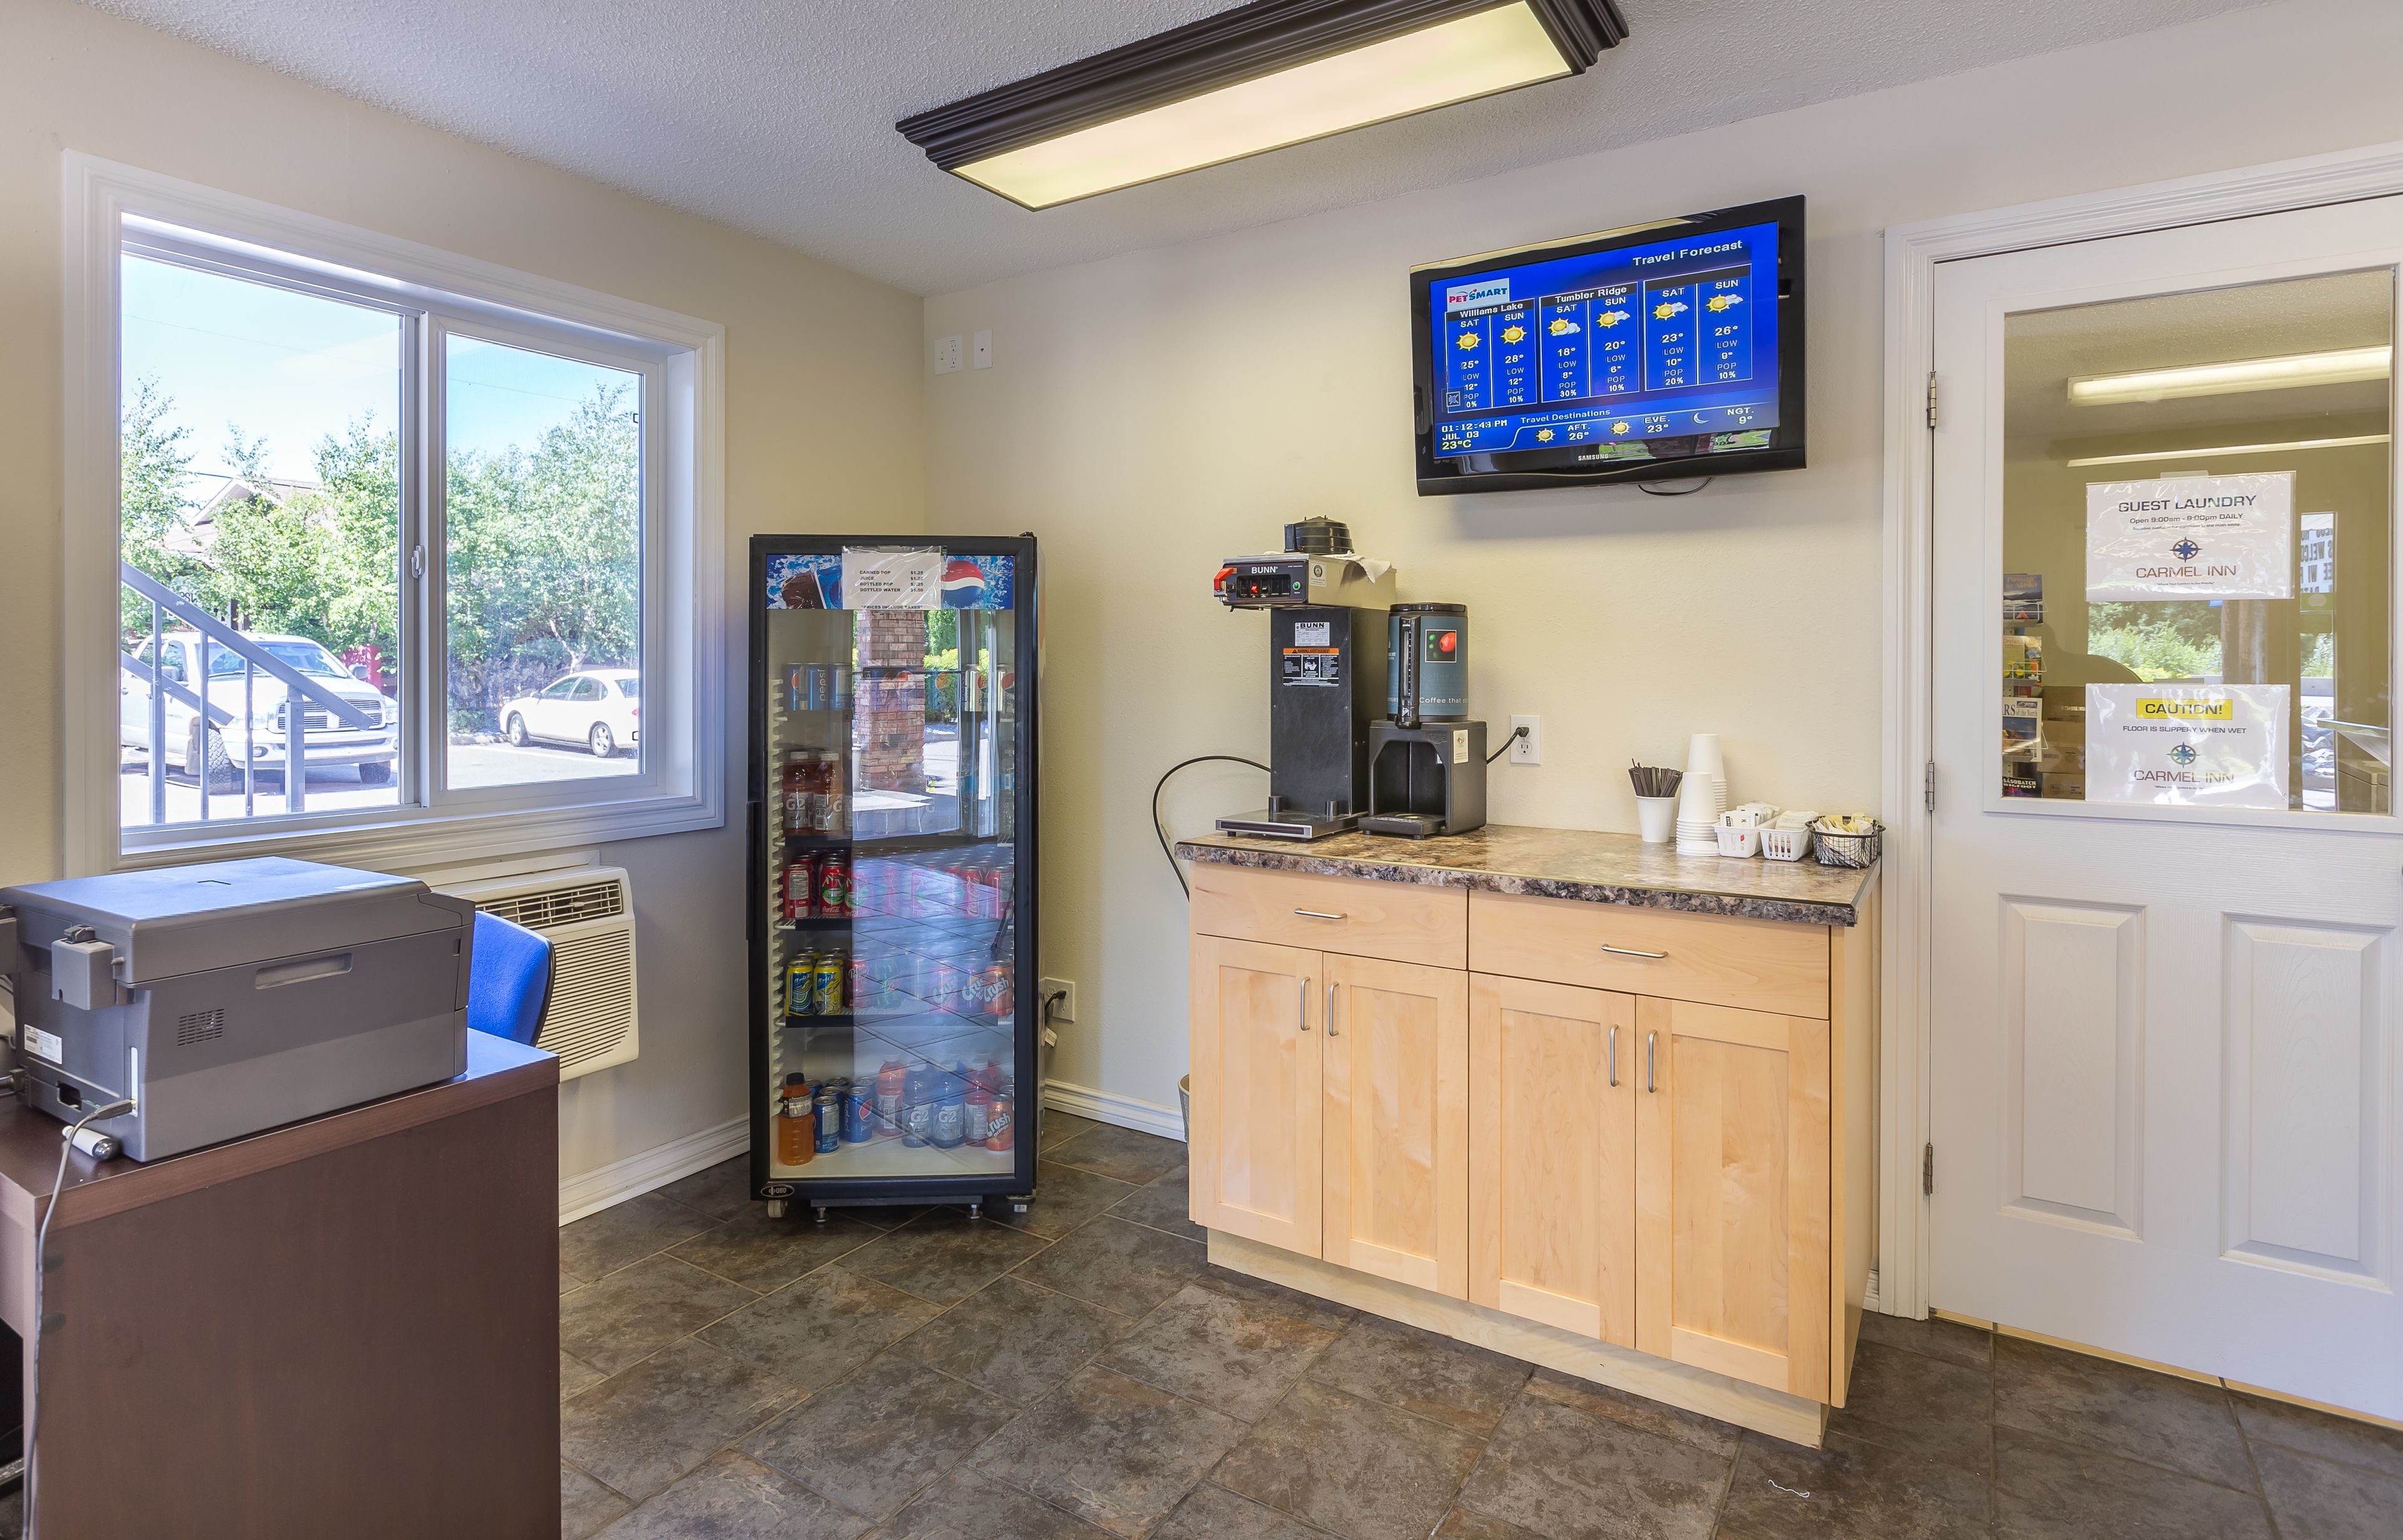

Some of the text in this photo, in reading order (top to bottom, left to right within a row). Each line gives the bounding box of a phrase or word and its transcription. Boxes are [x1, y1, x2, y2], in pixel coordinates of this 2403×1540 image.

[1633, 240, 1742, 265] Travel Forecast
[1715, 280, 1738, 289] SUN
[1554, 287, 1627, 303] Tumbler Ridge
[1662, 287, 1685, 297] SAT
[1605, 297, 1626, 306] SUN
[1460, 303, 1524, 318] Williams Lake
[1556, 304, 1578, 313] SAT
[1504, 312, 1524, 321] SUN
[1460, 319, 1479, 328] SAT
[1662, 333, 1684, 344] 23°
[1605, 340, 1625, 351] 20°
[1717, 340, 1738, 349] LOW
[1558, 347, 1576, 357] 18°
[1664, 347, 1684, 355] LOW
[1606, 354, 1626, 362] LOW
[1666, 358, 1682, 366] 10°
[1558, 360, 1576, 369] LOW
[1717, 362, 1737, 370] POP
[1664, 369, 1683, 377] POP
[1719, 371, 1736, 379] 10%
[1607, 375, 1625, 384] POP
[1665, 377, 1683, 385] 20%
[1609, 384, 1625, 392] 10%
[1559, 389, 1576, 397] 30%
[1727, 407, 1754, 416] NGT.
[1521, 409, 1611, 424] Travel Destinations
[1644, 416, 1670, 424] EVE.
[1647, 424, 1669, 433] 23°
[1569, 432, 1589, 441] 26°
[2119, 495, 2257, 512] GUEST LAUNDRY
[2136, 565, 2237, 578] CARMEL INN
[817, 668, 827, 701] pepsi
[2145, 703, 2222, 715] CAUTION!
[2134, 770, 2234, 783] CARMEL INN
